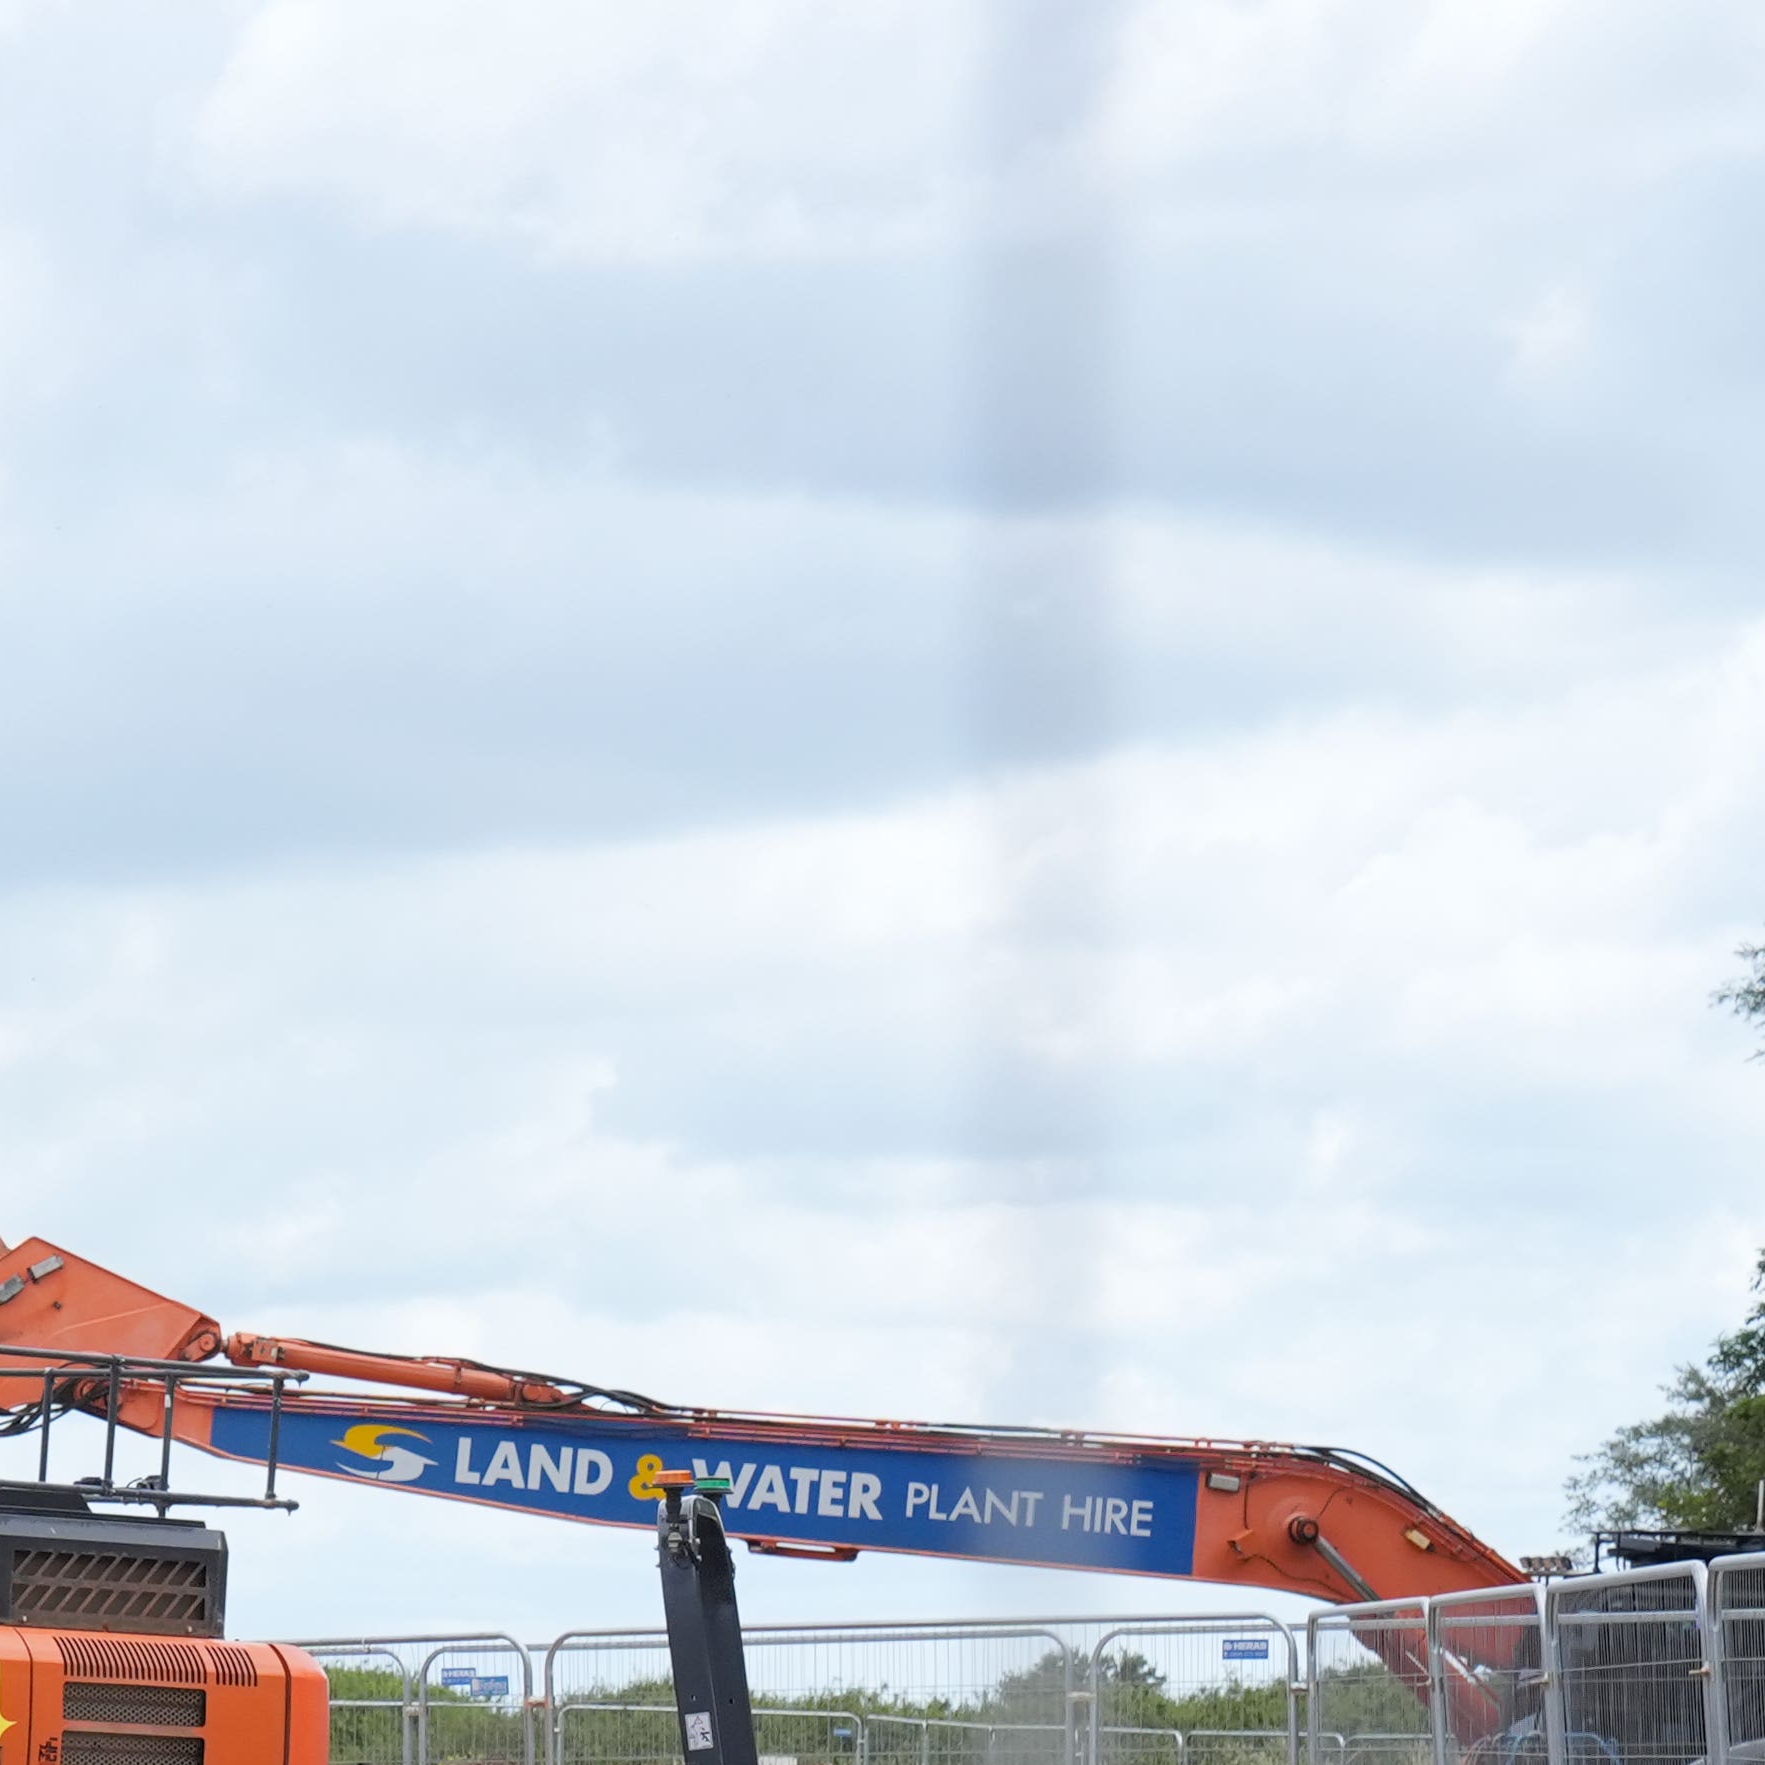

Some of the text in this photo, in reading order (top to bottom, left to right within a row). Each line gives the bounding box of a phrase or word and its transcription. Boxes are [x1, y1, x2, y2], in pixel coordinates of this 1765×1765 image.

[455, 1437, 1154, 1537] LAND & WATER PLANT HIRE
